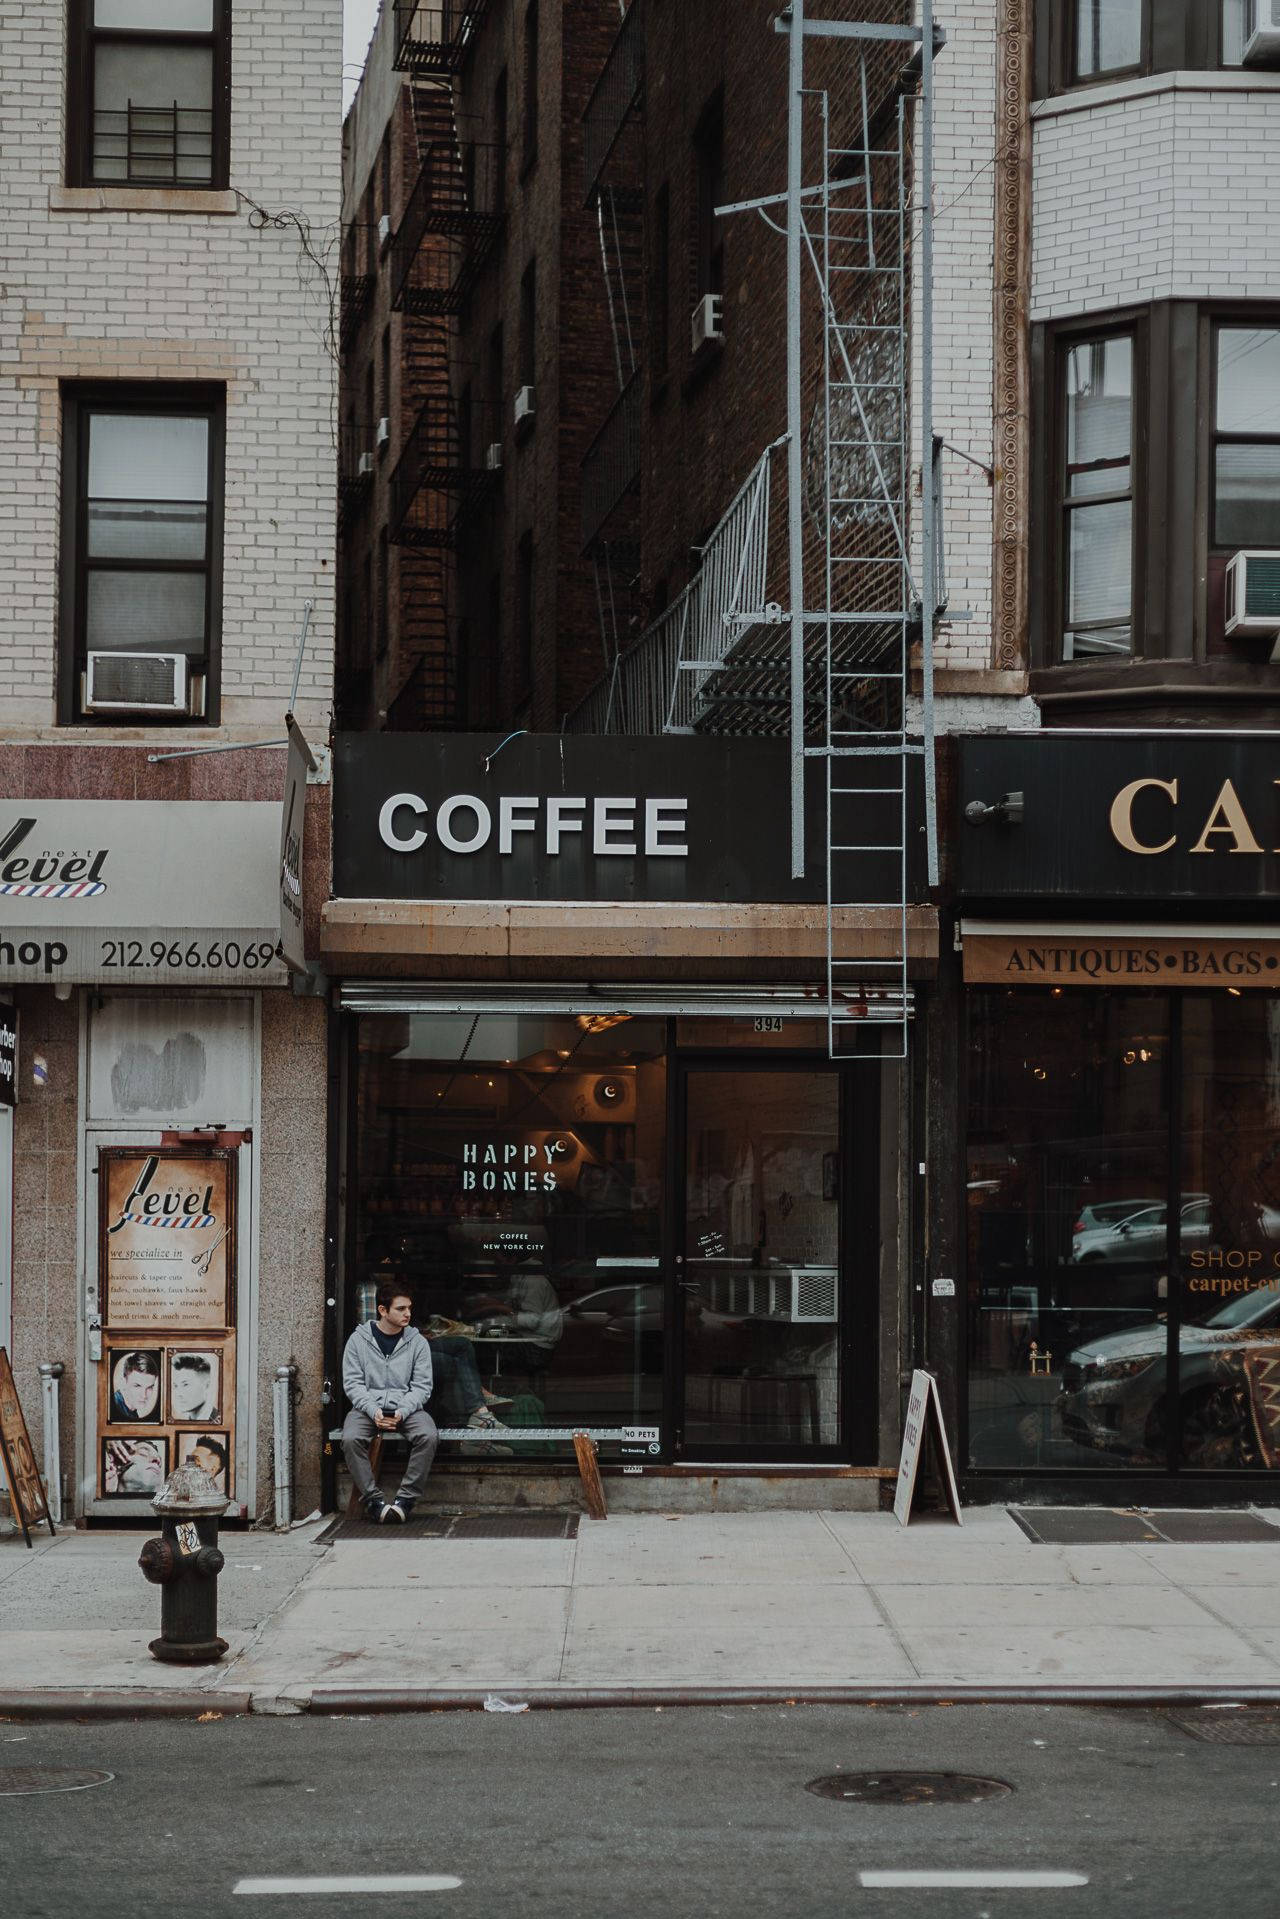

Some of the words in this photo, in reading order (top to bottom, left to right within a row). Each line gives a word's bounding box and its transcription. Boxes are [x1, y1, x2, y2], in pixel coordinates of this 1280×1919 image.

[378, 793, 688, 855] COFFEE
[1110, 778, 1280, 854] CA
[42, 849, 92, 857] next
[101, 941, 275, 968] 212.966.6069
[1005, 949, 1160, 977] ANTIQUES
[1182, 950, 1261, 975] BAGS
[755, 1016, 782, 1031] 394
[463, 1144, 556, 1164] HAPPY
[463, 1170, 556, 1191] BONES
[110, 1250, 122, 1258] we
[126, 1248, 170, 1260] specialize
[173, 1249, 183, 1258] in
[1190, 1250, 1262, 1268] SHOP
